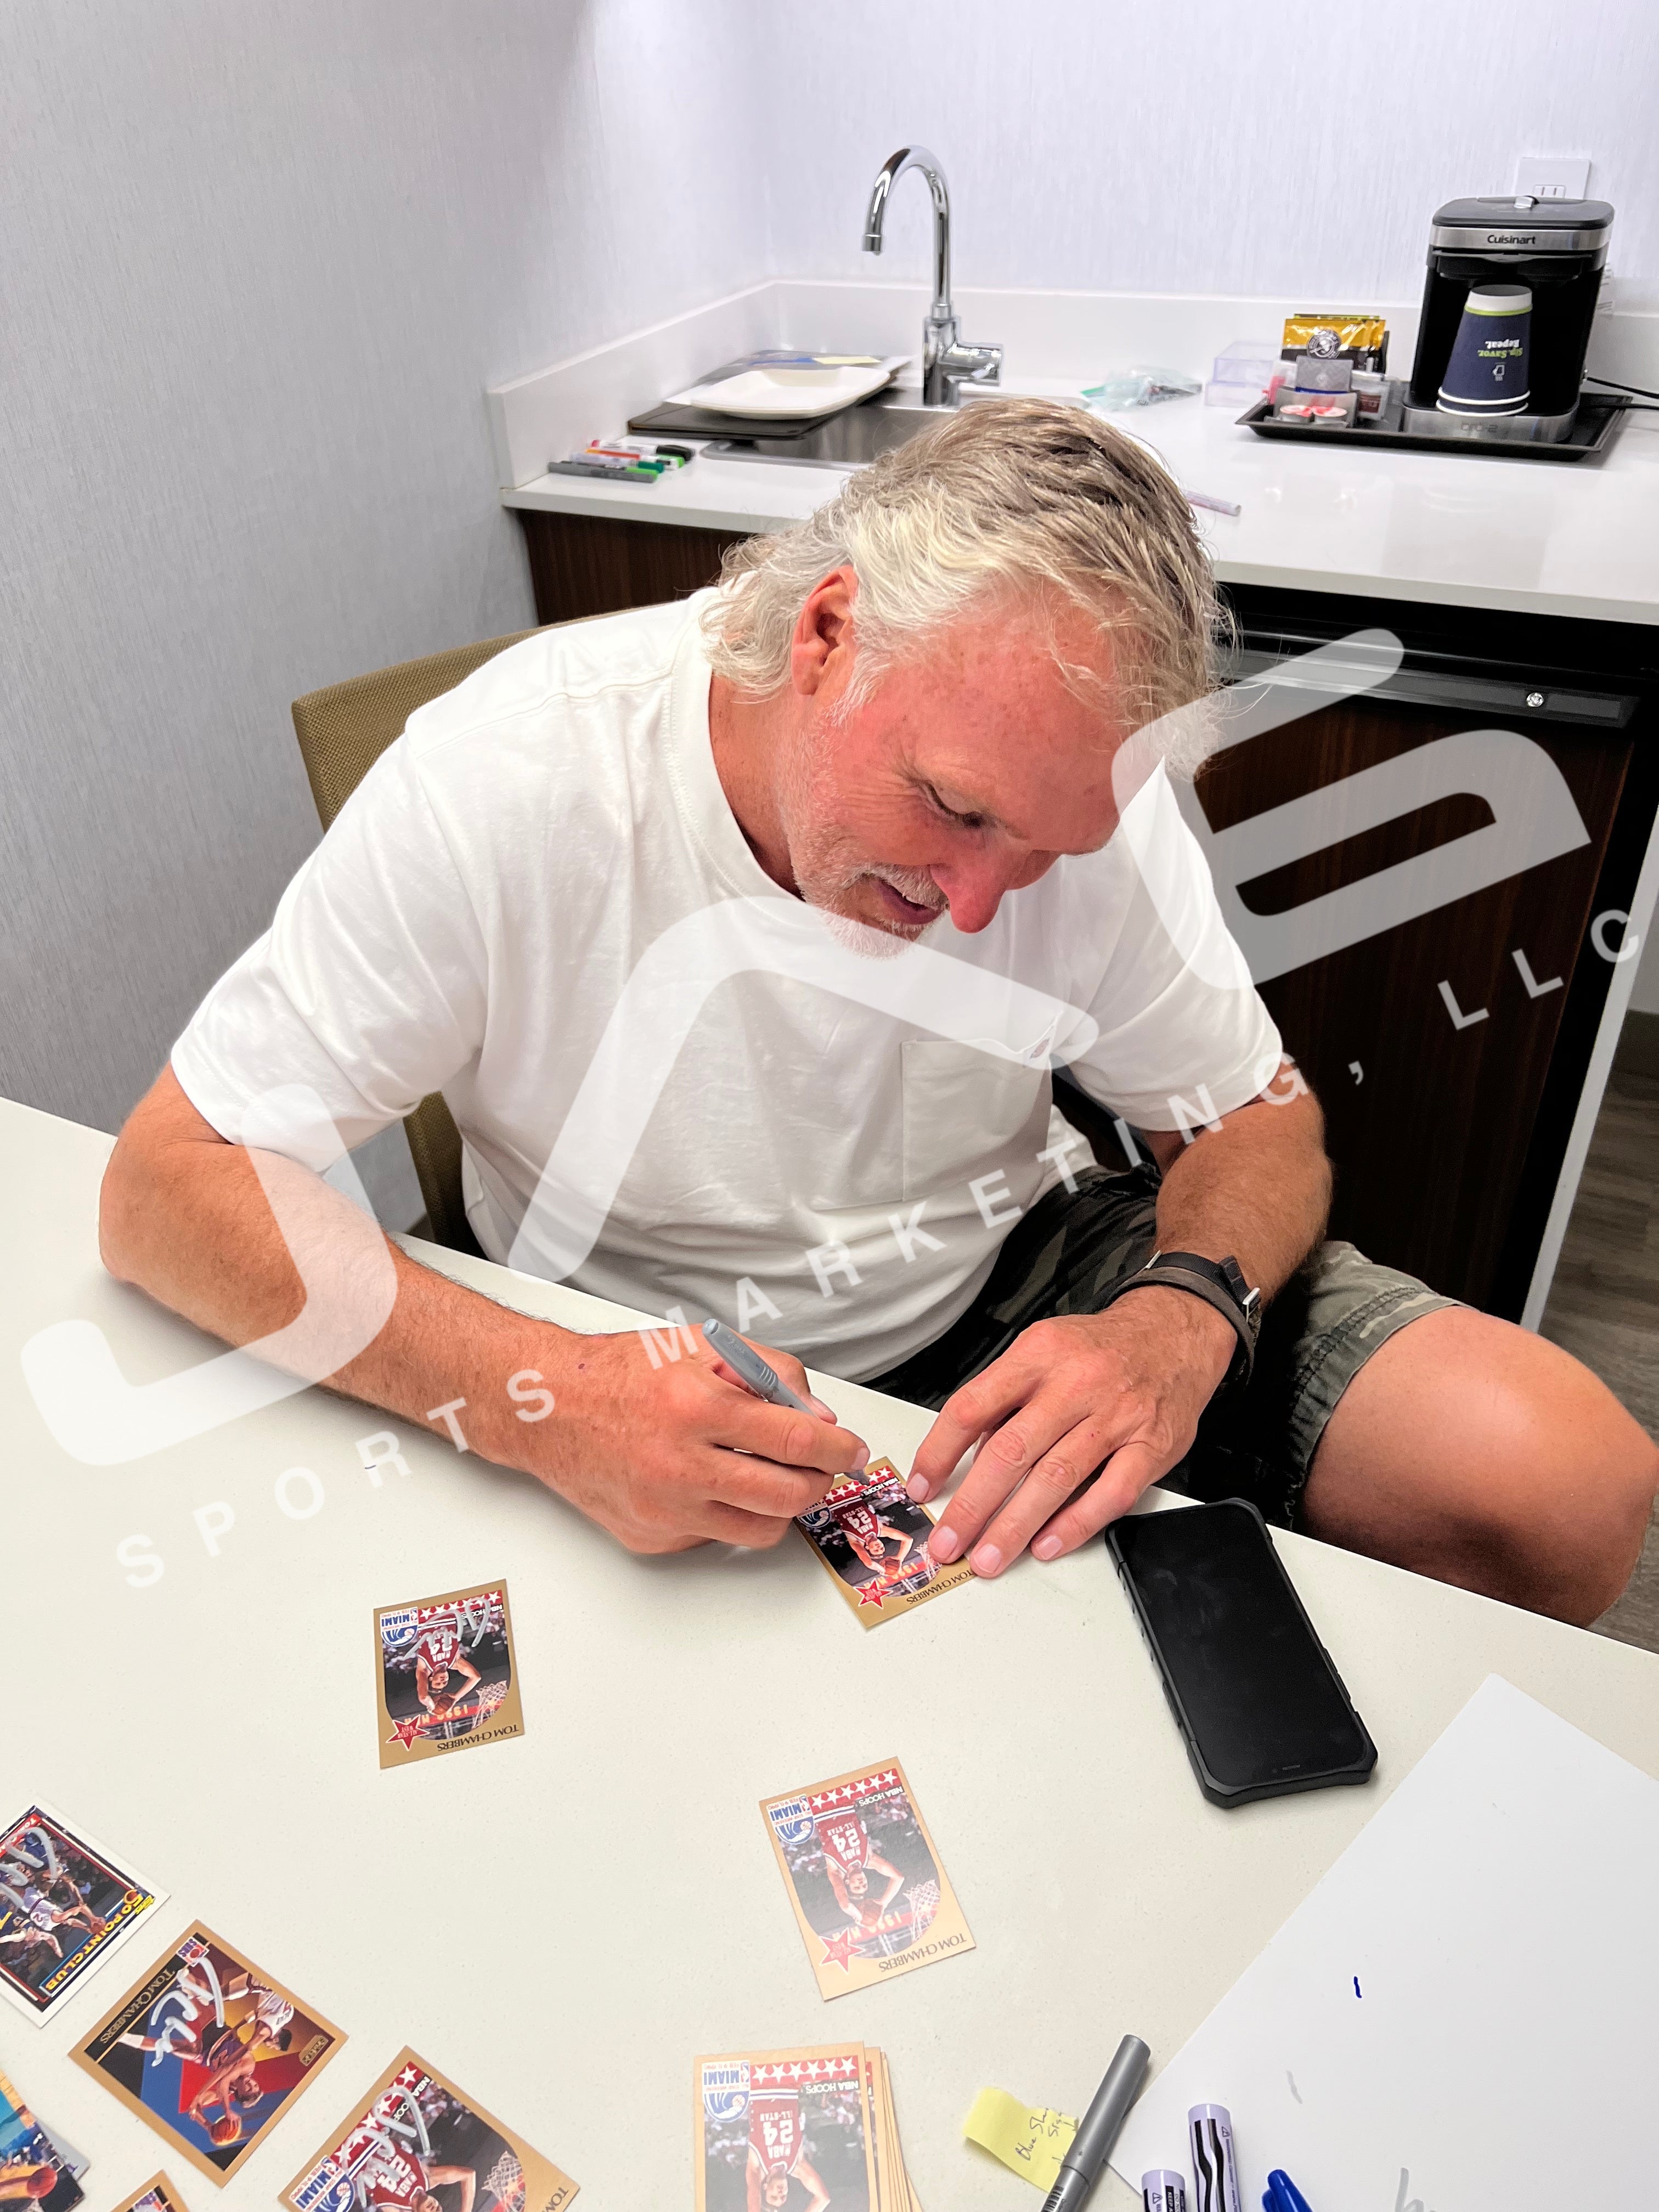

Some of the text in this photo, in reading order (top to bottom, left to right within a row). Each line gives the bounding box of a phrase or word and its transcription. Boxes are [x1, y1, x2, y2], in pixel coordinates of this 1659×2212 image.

[1487, 234, 1536, 245] Cuisinart
[863, 1483, 885, 1496] HOOPS
[847, 1510, 872, 1529] 24
[906, 1579, 952, 1605] CHAMBERS
[381, 1614, 410, 1627] MIAMI
[437, 1724, 520, 1752] TOM CHAMBERS
[859, 1786, 904, 1807] NBA HOOPS
[769, 1803, 802, 1821] MIAMI
[831, 1828, 861, 1853] 24
[44, 1889, 144, 1991] 50 POINT CLUB
[878, 1933, 967, 1972] TOM CHAMBERS
[411, 2076, 431, 2097] NBA
[703, 2070, 740, 2085] MIAMI
[838, 2080, 859, 2091] NBA
[805, 2084, 837, 2094] HOOPS
[763, 2119, 794, 2146] 24
[295, 2170, 331, 2210] MIAMI
